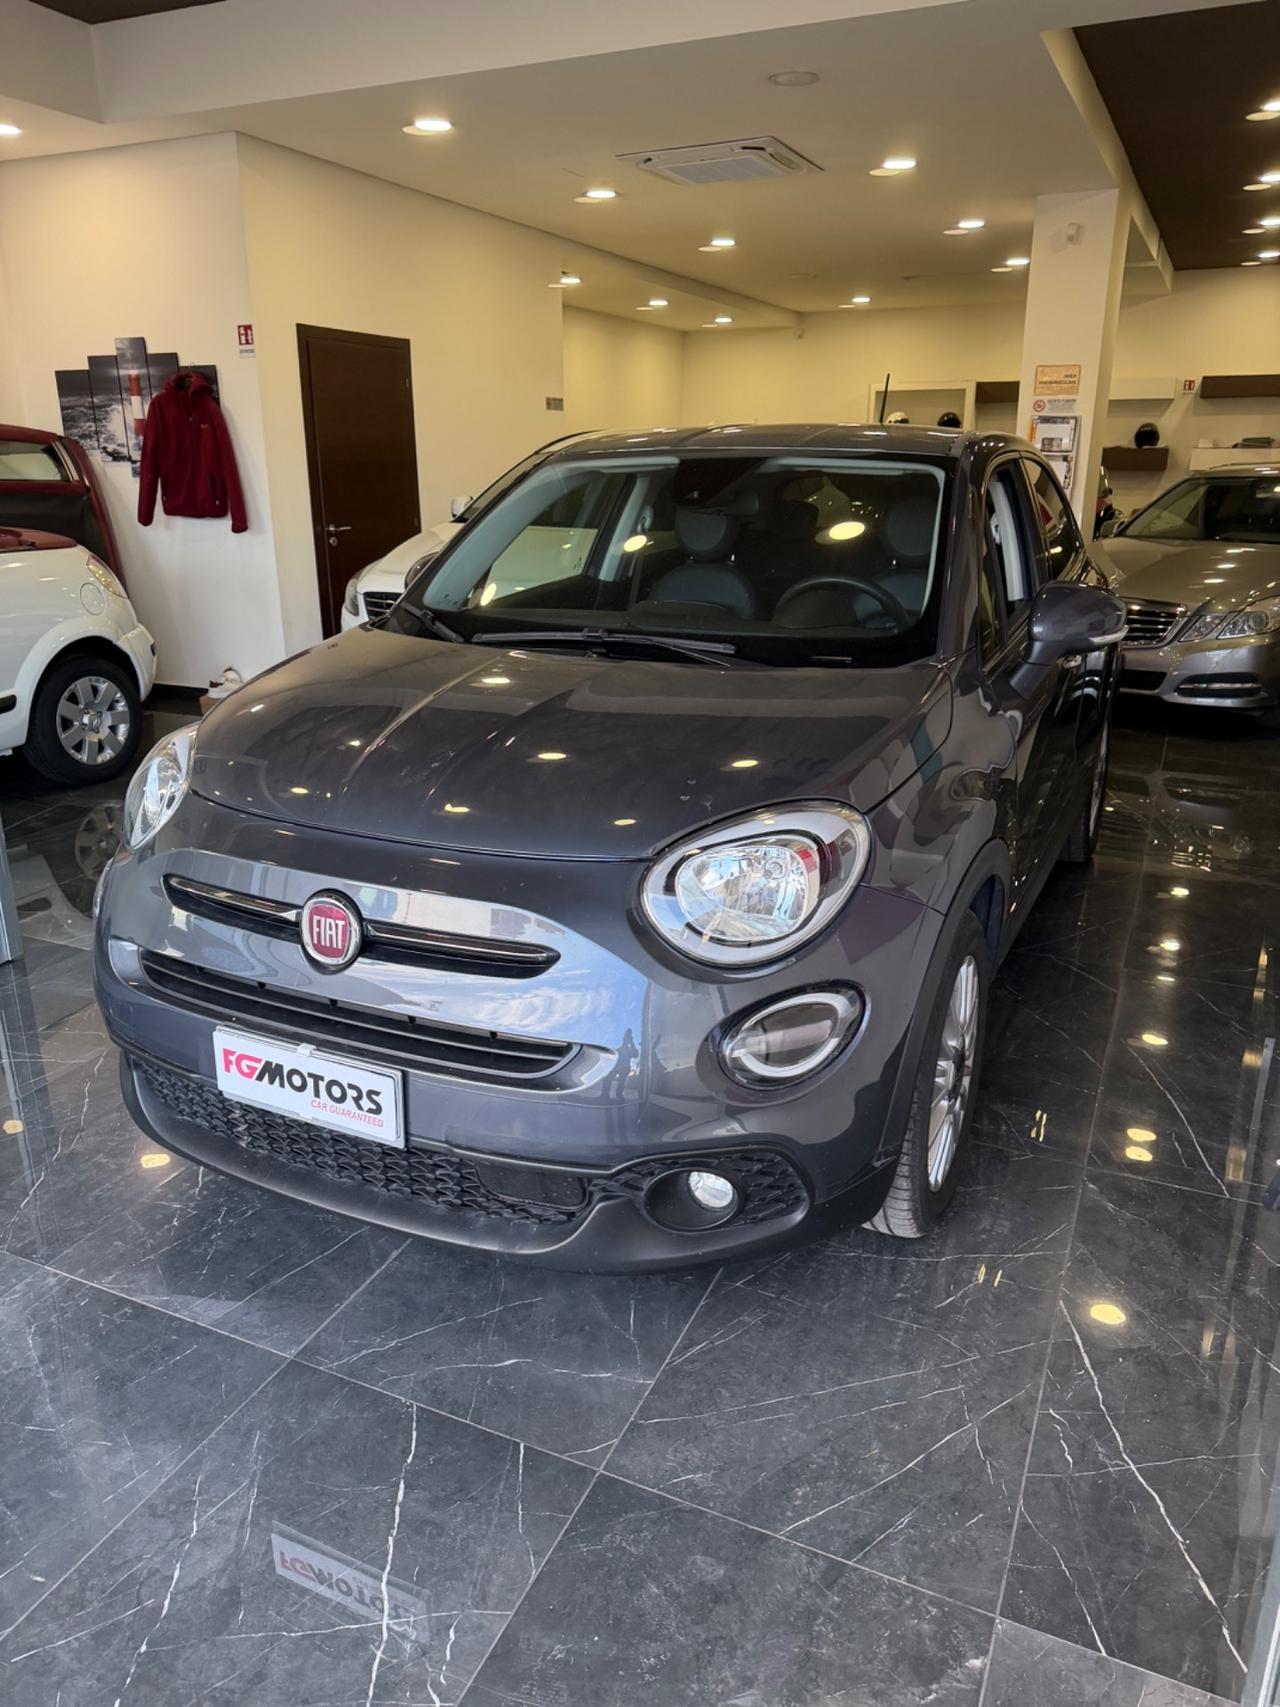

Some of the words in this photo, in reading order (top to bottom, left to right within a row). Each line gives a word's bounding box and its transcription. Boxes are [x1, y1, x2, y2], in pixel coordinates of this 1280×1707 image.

[313, 914, 346, 949] FIAT
[310, 1099, 328, 1112] CAR
[329, 1105, 384, 1128] GUARANTEED
